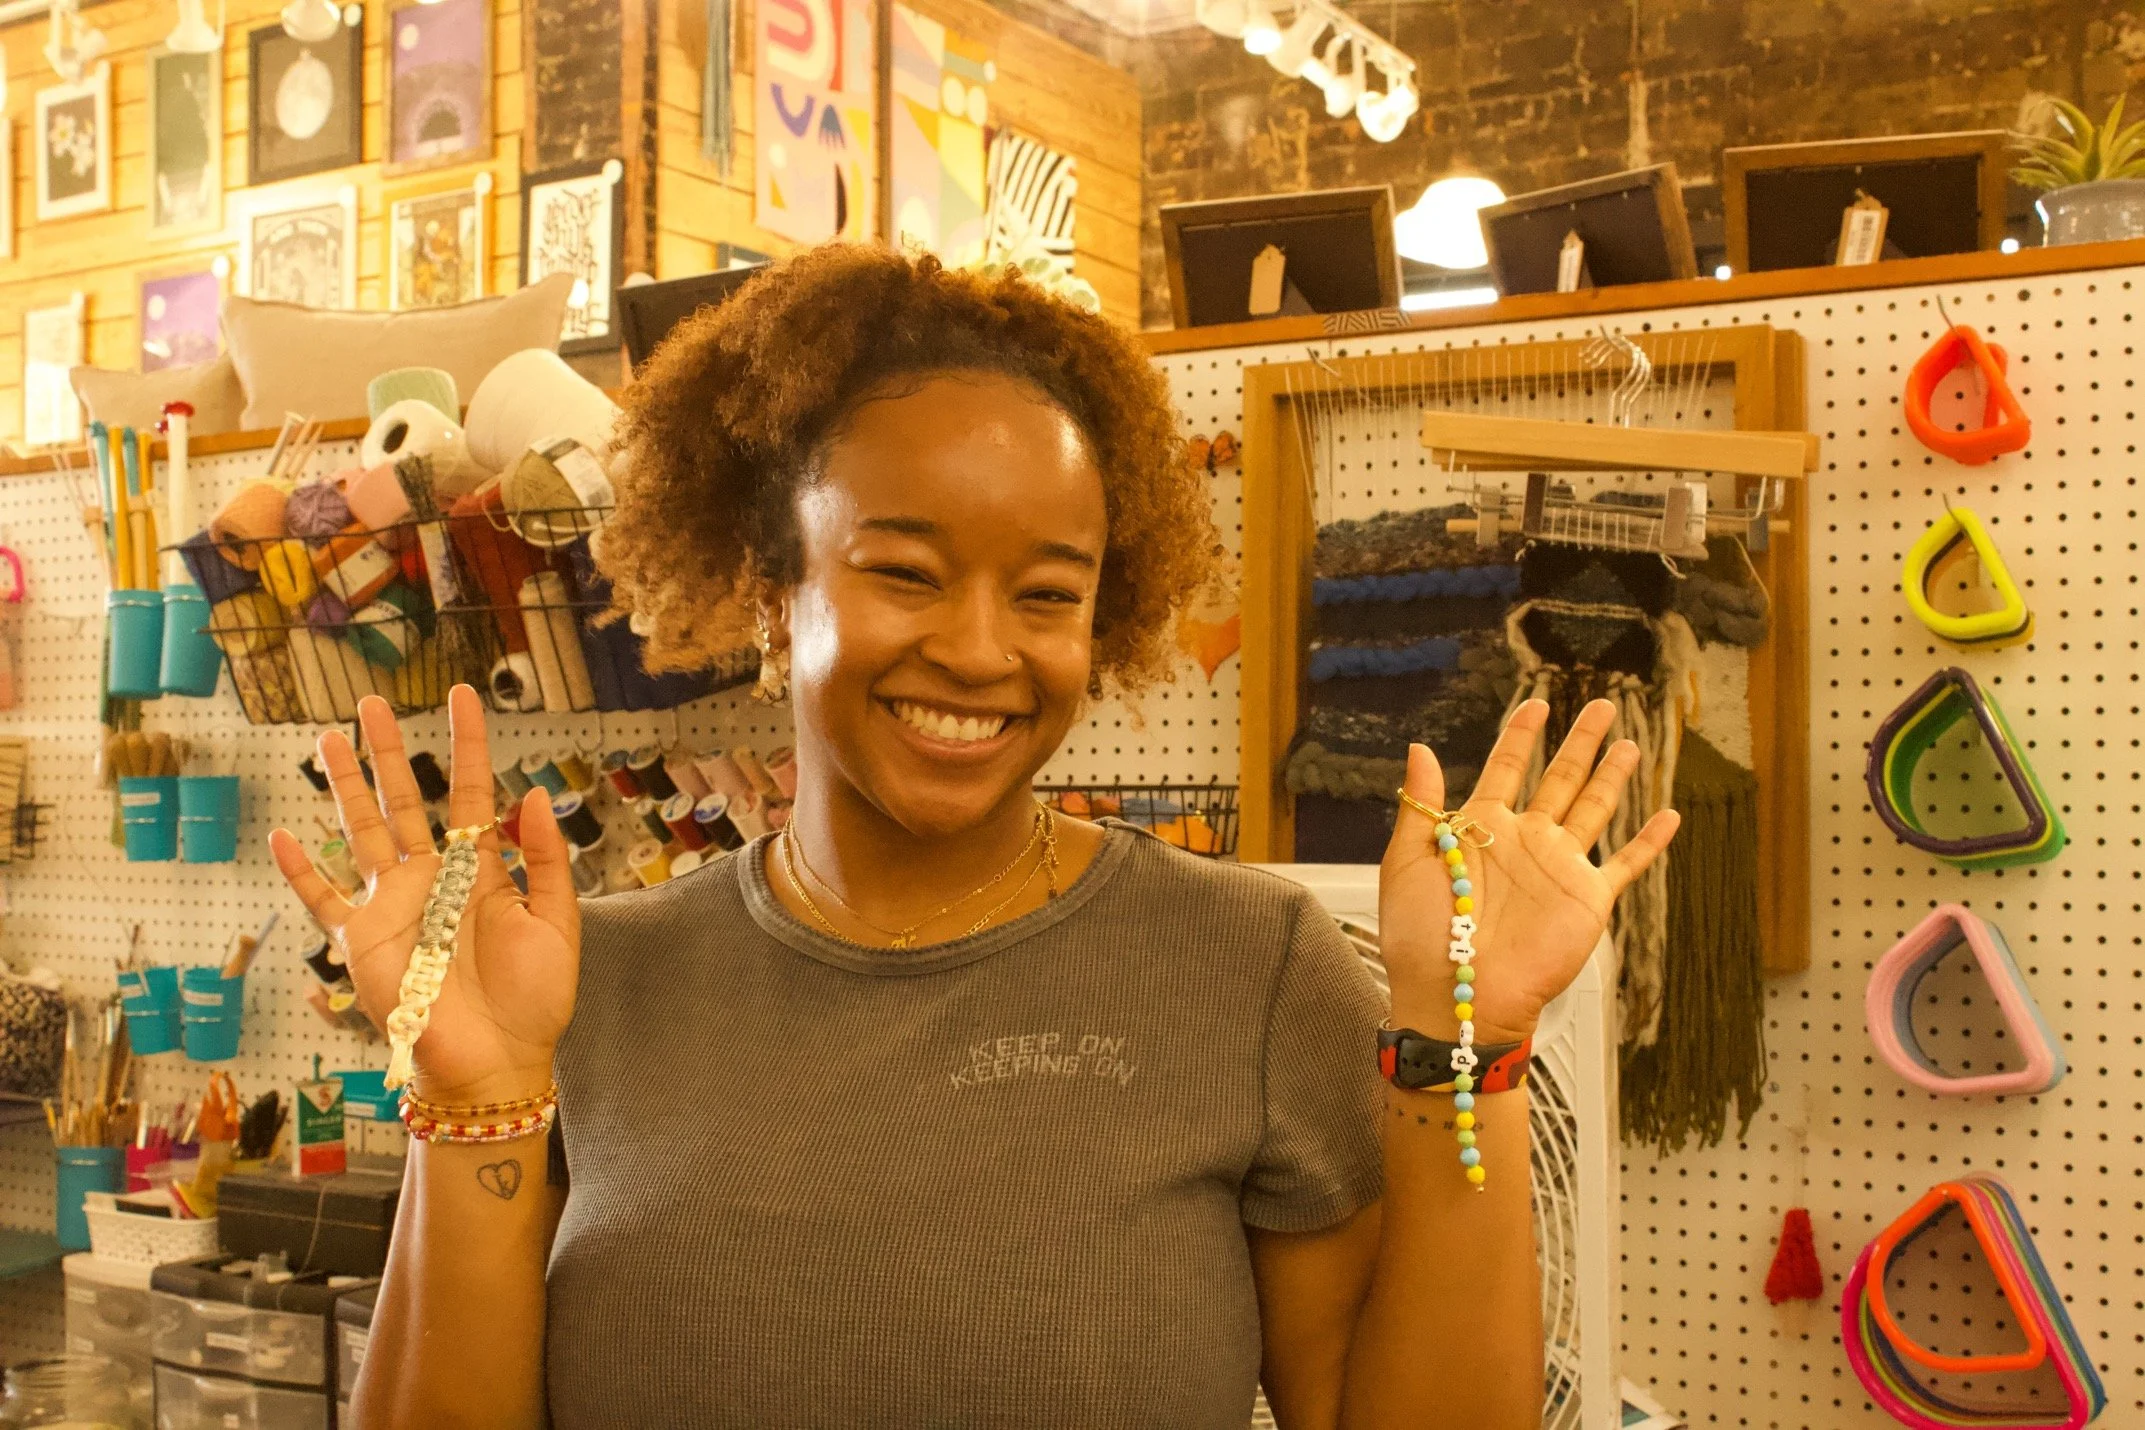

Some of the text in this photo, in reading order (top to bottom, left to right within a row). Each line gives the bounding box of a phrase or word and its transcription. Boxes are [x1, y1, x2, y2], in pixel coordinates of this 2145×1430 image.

[968, 1031, 1126, 1063] KEEP ON
[950, 1053, 1136, 1090] KEEPING ON
